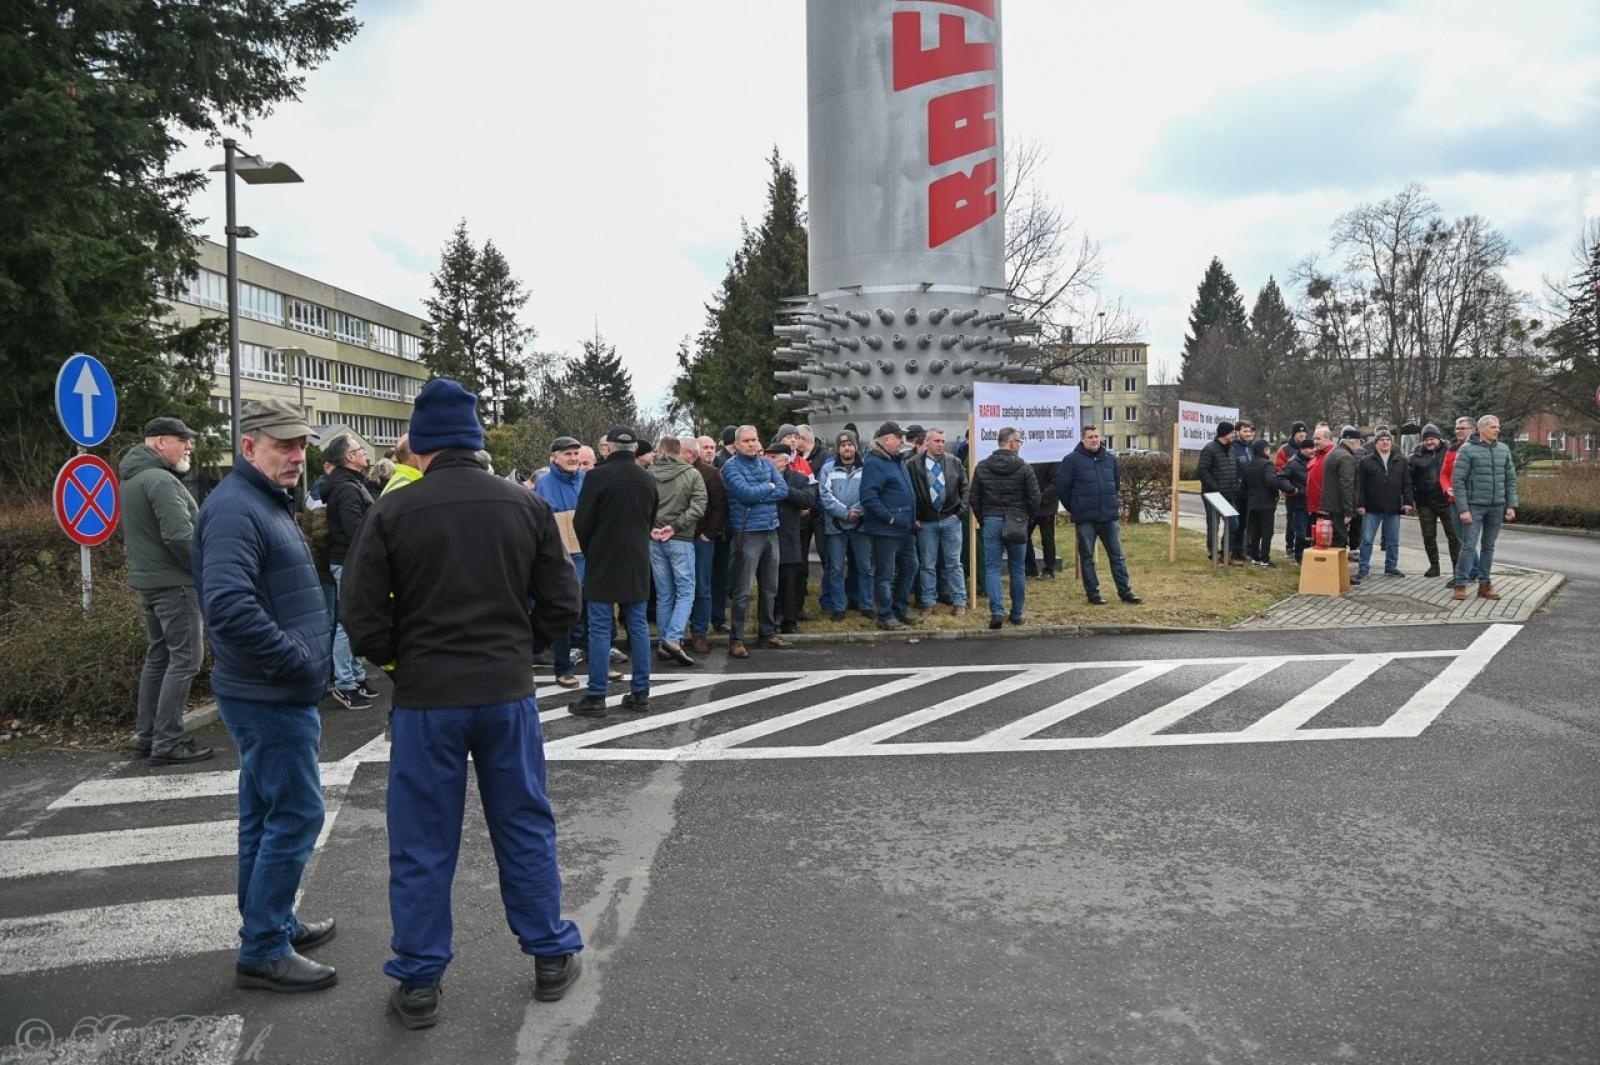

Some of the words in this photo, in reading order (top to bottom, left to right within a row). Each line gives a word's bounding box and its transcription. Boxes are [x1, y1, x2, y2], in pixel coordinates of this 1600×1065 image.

[892, 0, 998, 249] RAF
[979, 405, 1000, 417] RAFAKO
[1026, 405, 1052, 417] zachodnie
[1029, 429, 1045, 441] swego
[1046, 428, 1055, 439] nie
